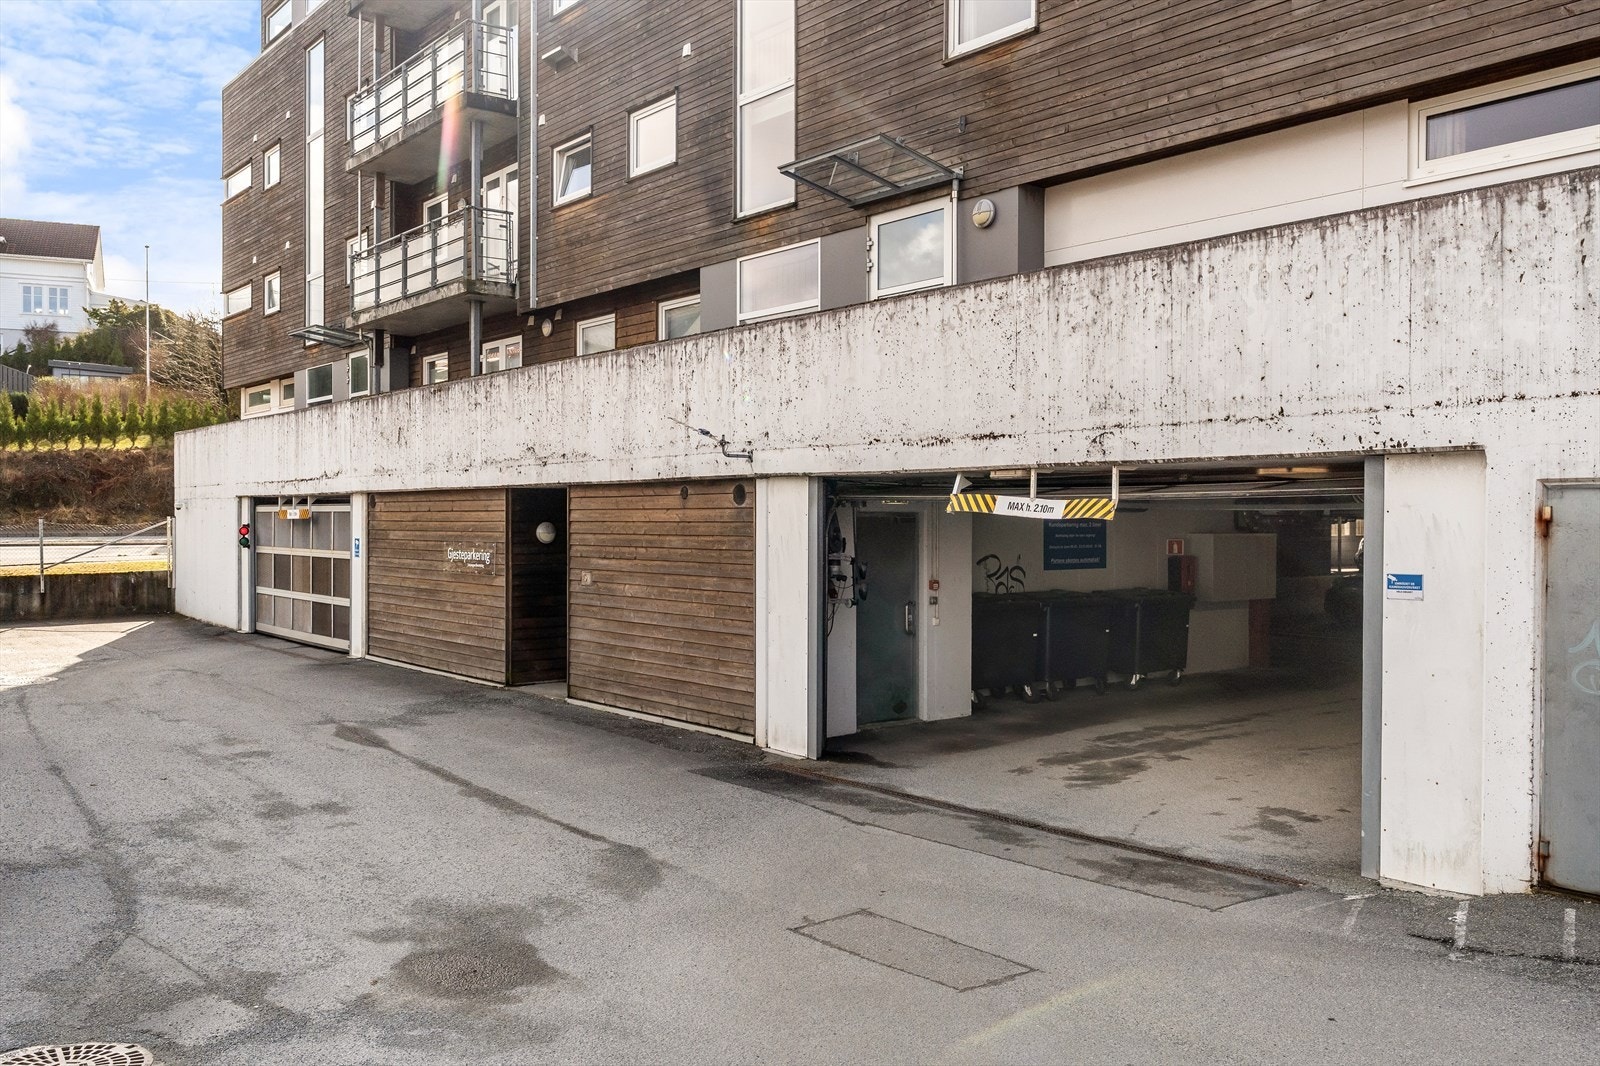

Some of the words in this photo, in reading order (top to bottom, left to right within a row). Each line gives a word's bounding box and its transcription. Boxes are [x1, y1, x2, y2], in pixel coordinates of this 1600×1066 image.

[1007, 502, 1025, 511] MAX
[1025, 503, 1032, 512] h.
[1033, 504, 1055, 513] 2.10m
[448, 547, 490, 564] Gjesteparkering
